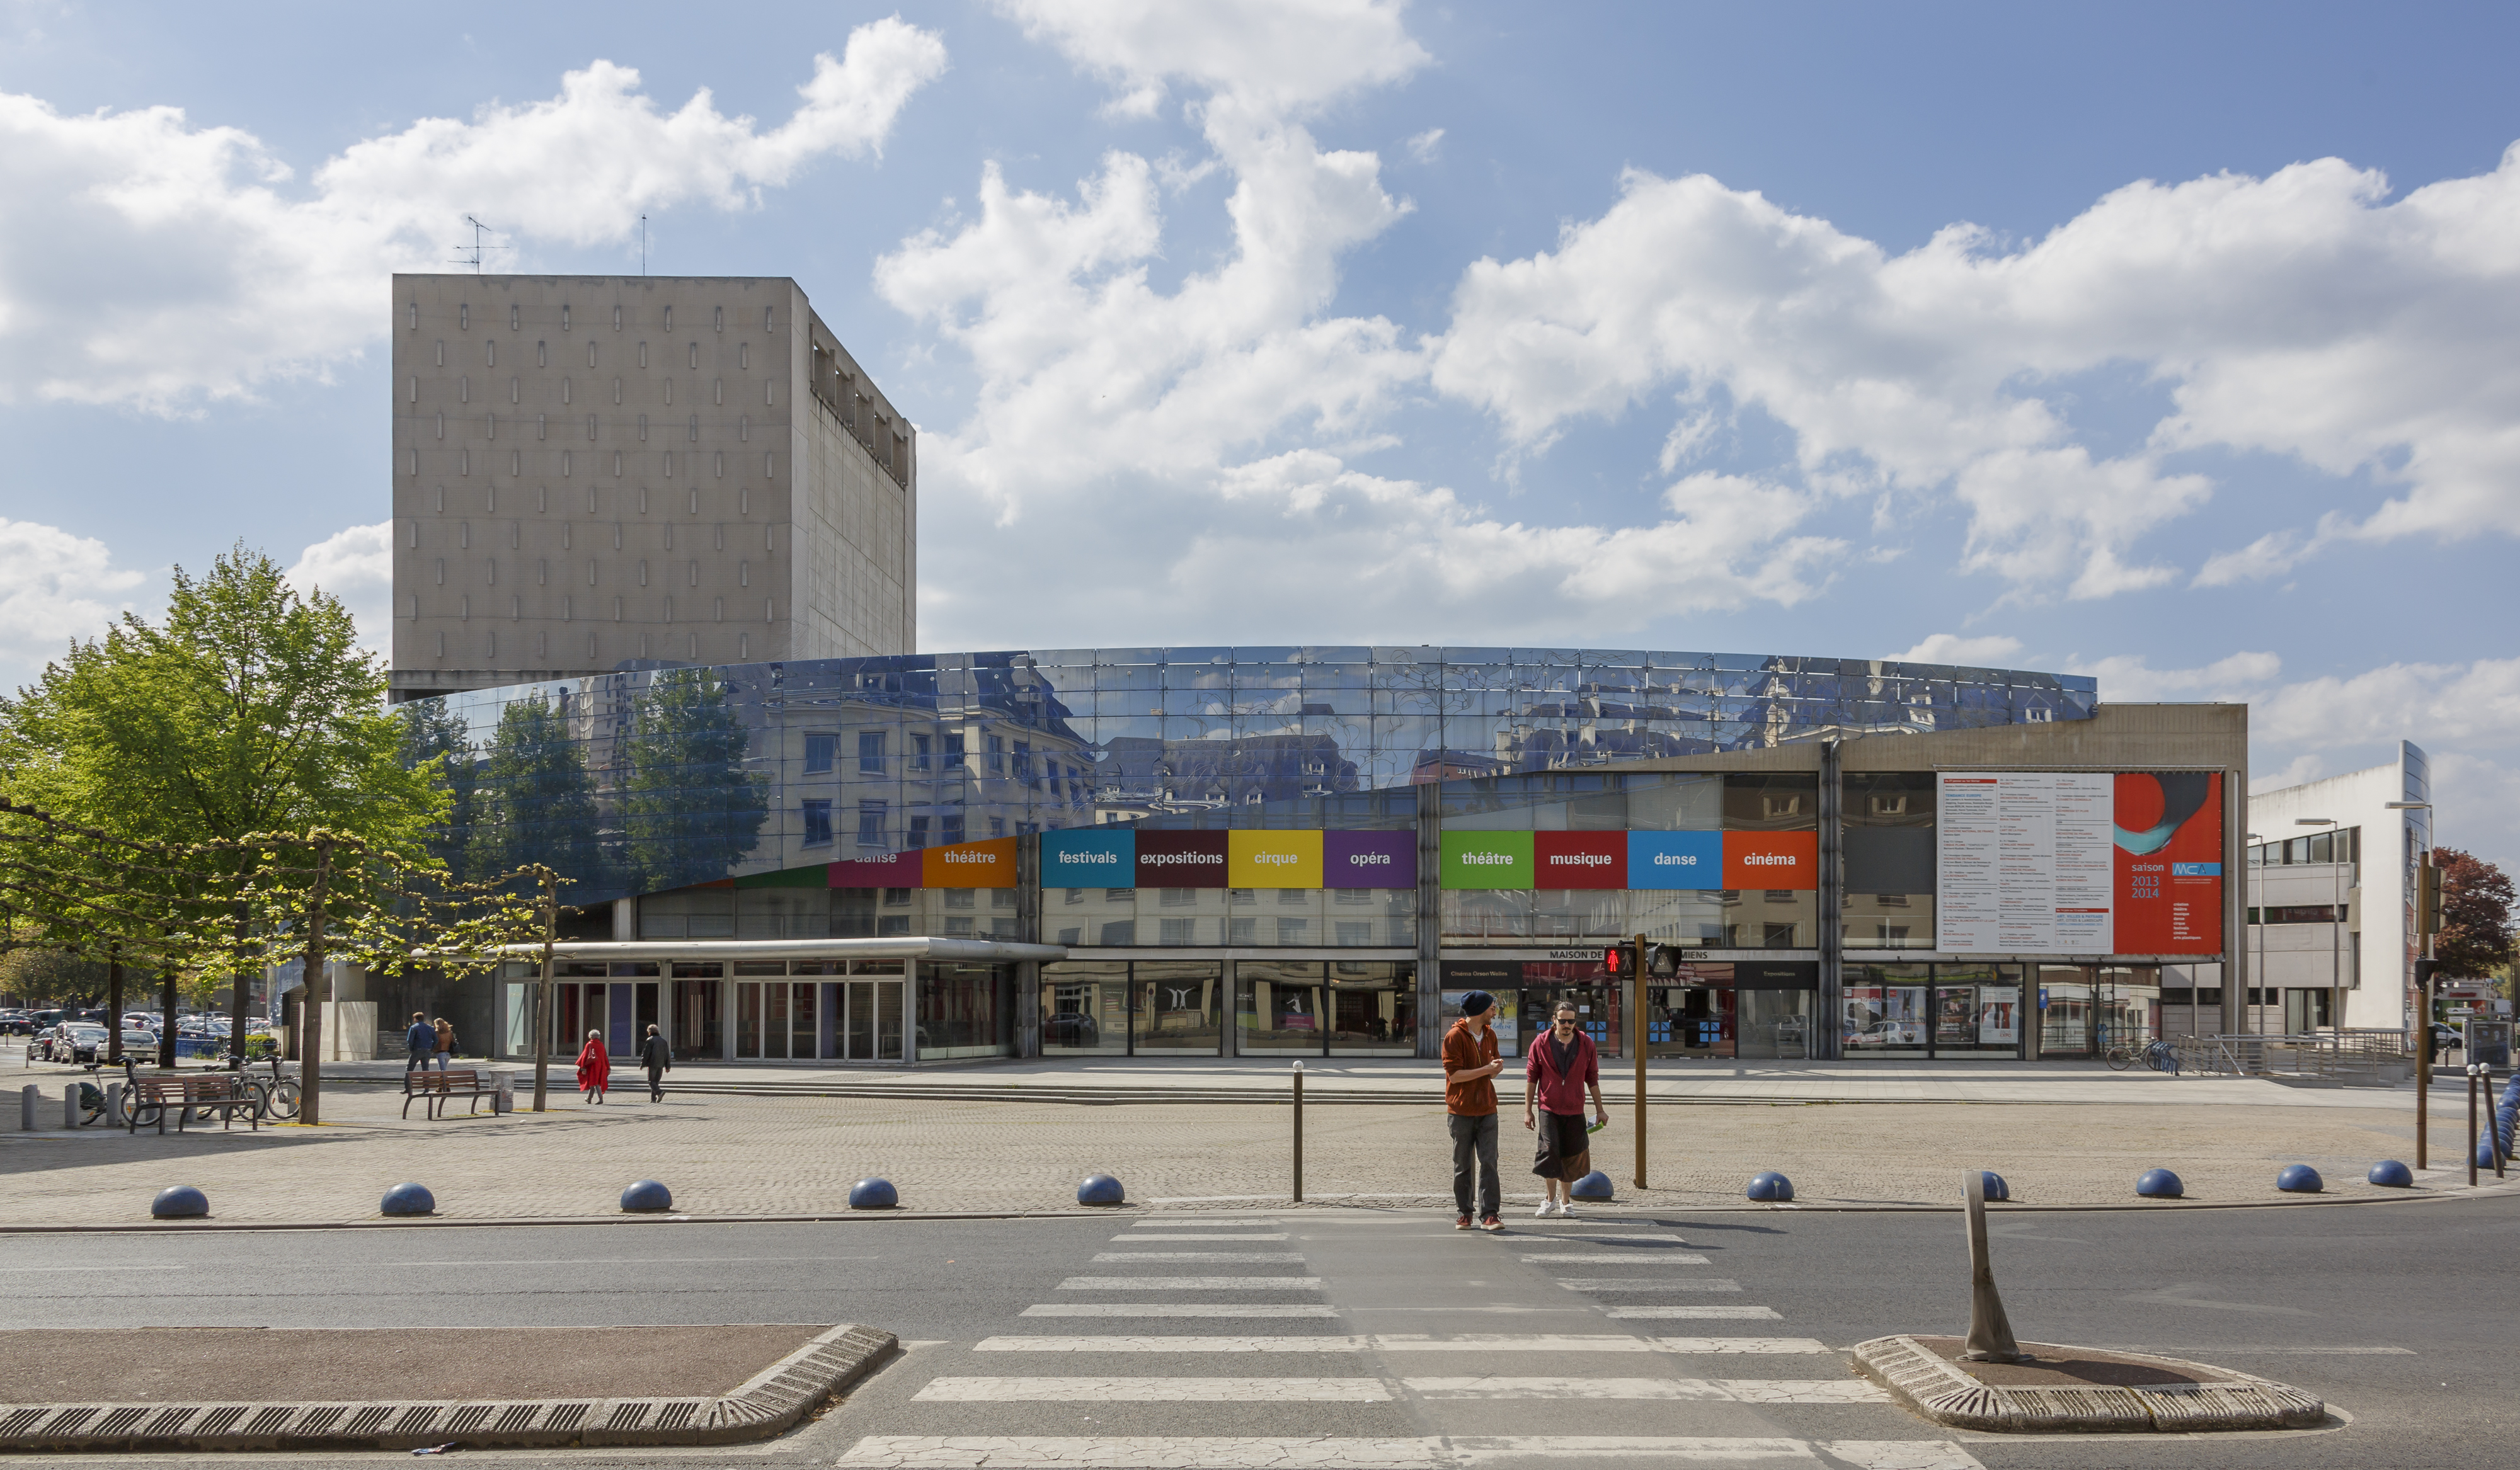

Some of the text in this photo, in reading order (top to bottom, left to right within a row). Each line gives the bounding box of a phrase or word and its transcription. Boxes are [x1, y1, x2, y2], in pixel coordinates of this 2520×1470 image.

[944, 851, 995, 863] théâtre
[1059, 851, 1117, 863] festivals
[1141, 851, 1223, 867] expositions
[1254, 851, 1297, 866] cirque
[1351, 852, 1390, 867] opéra
[1462, 852, 1513, 865] théâtre
[1550, 852, 1612, 867] musique
[1654, 852, 1697, 865] danse
[1744, 853, 1796, 865] cinéma
[2132, 863, 2164, 872] saison
[2174, 863, 2206, 874] MCA
[2132, 876, 2159, 886] 2013
[2132, 888, 2160, 898] 2014
